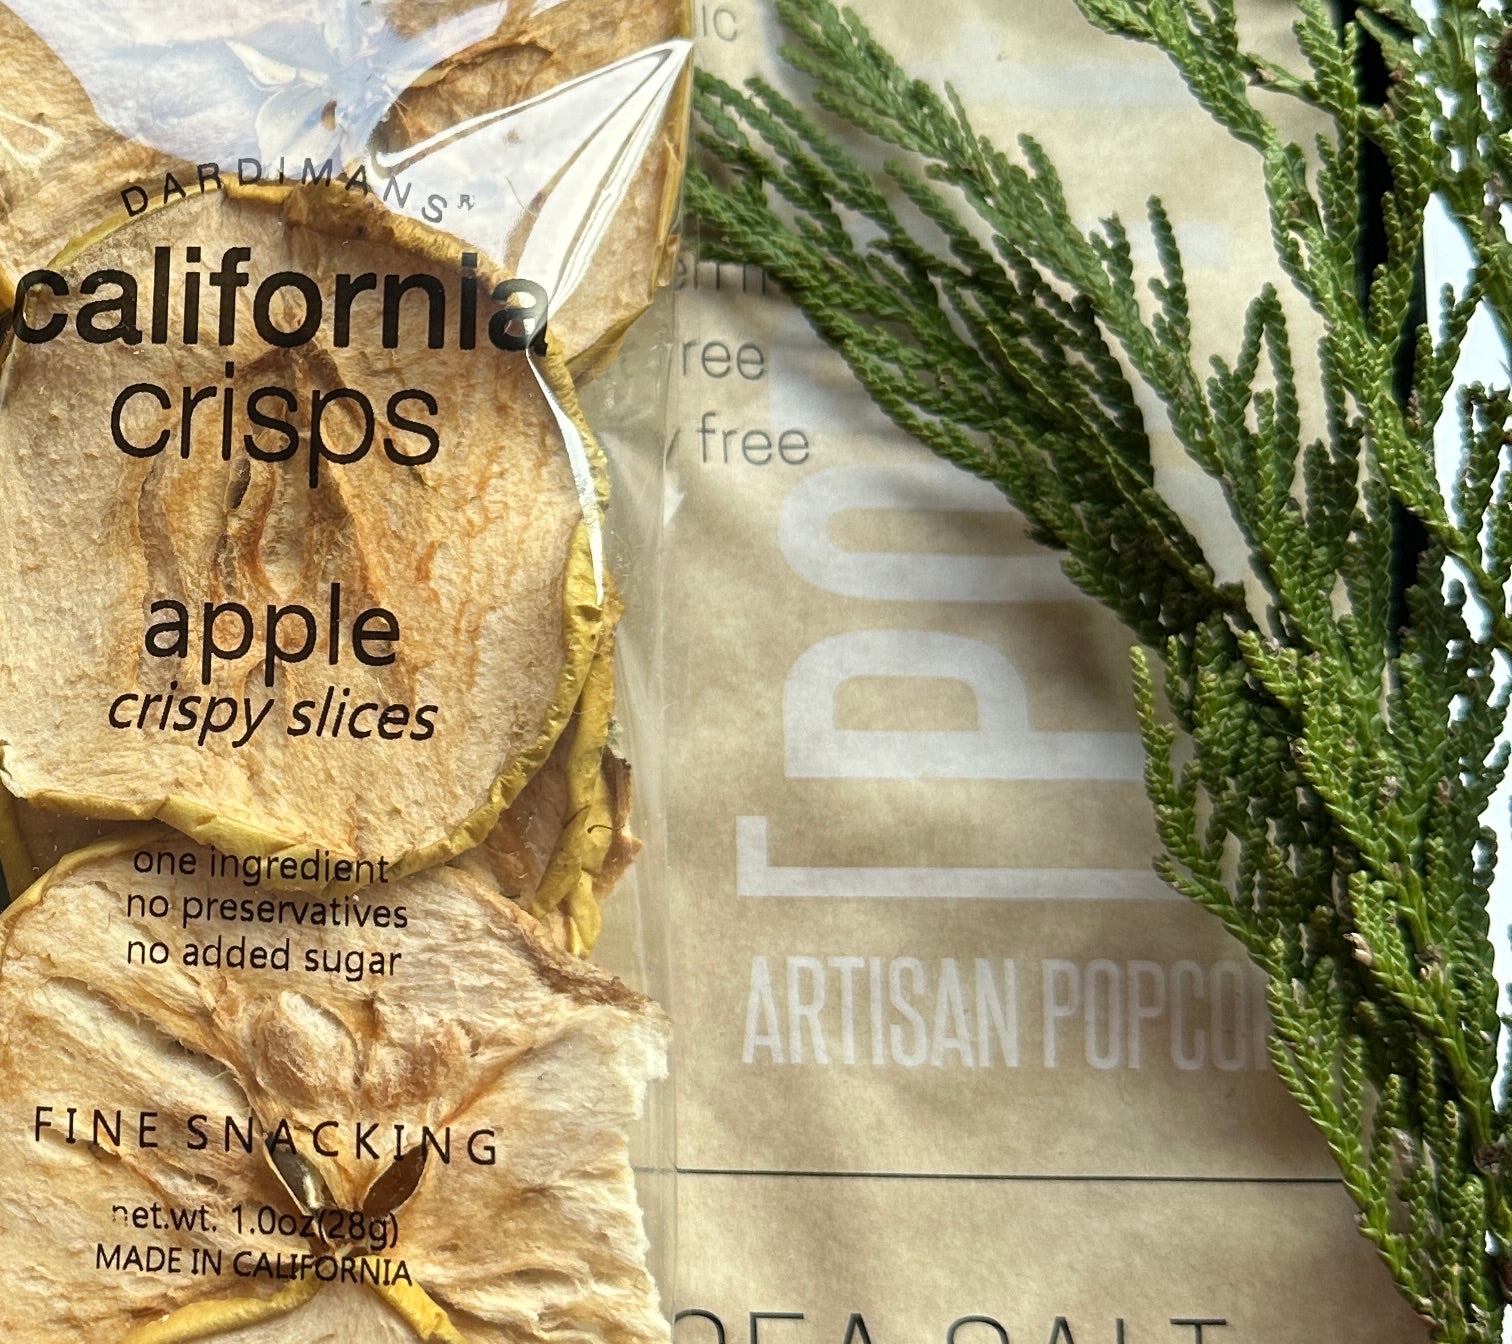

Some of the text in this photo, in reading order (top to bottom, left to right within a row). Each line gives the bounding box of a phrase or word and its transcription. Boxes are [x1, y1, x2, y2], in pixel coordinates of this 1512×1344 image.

[14, 246, 549, 356] california
[682, 337, 766, 380] ree
[110, 362, 439, 489] crisps
[695, 411, 810, 467] free
[144, 582, 400, 687] apple
[108, 681, 439, 748] crispy slices
[133, 848, 390, 886] one ingredient
[127, 892, 408, 929] no preservatives
[127, 935, 402, 983] no added sugar
[741, 956, 1020, 1069] ARTISAN
[34, 1105, 498, 1166] FINE SNACKING
[230, 1204, 399, 1251] 1.0oz(28g)
[95, 1243, 413, 1287] MADE IN CALIFORNIA
